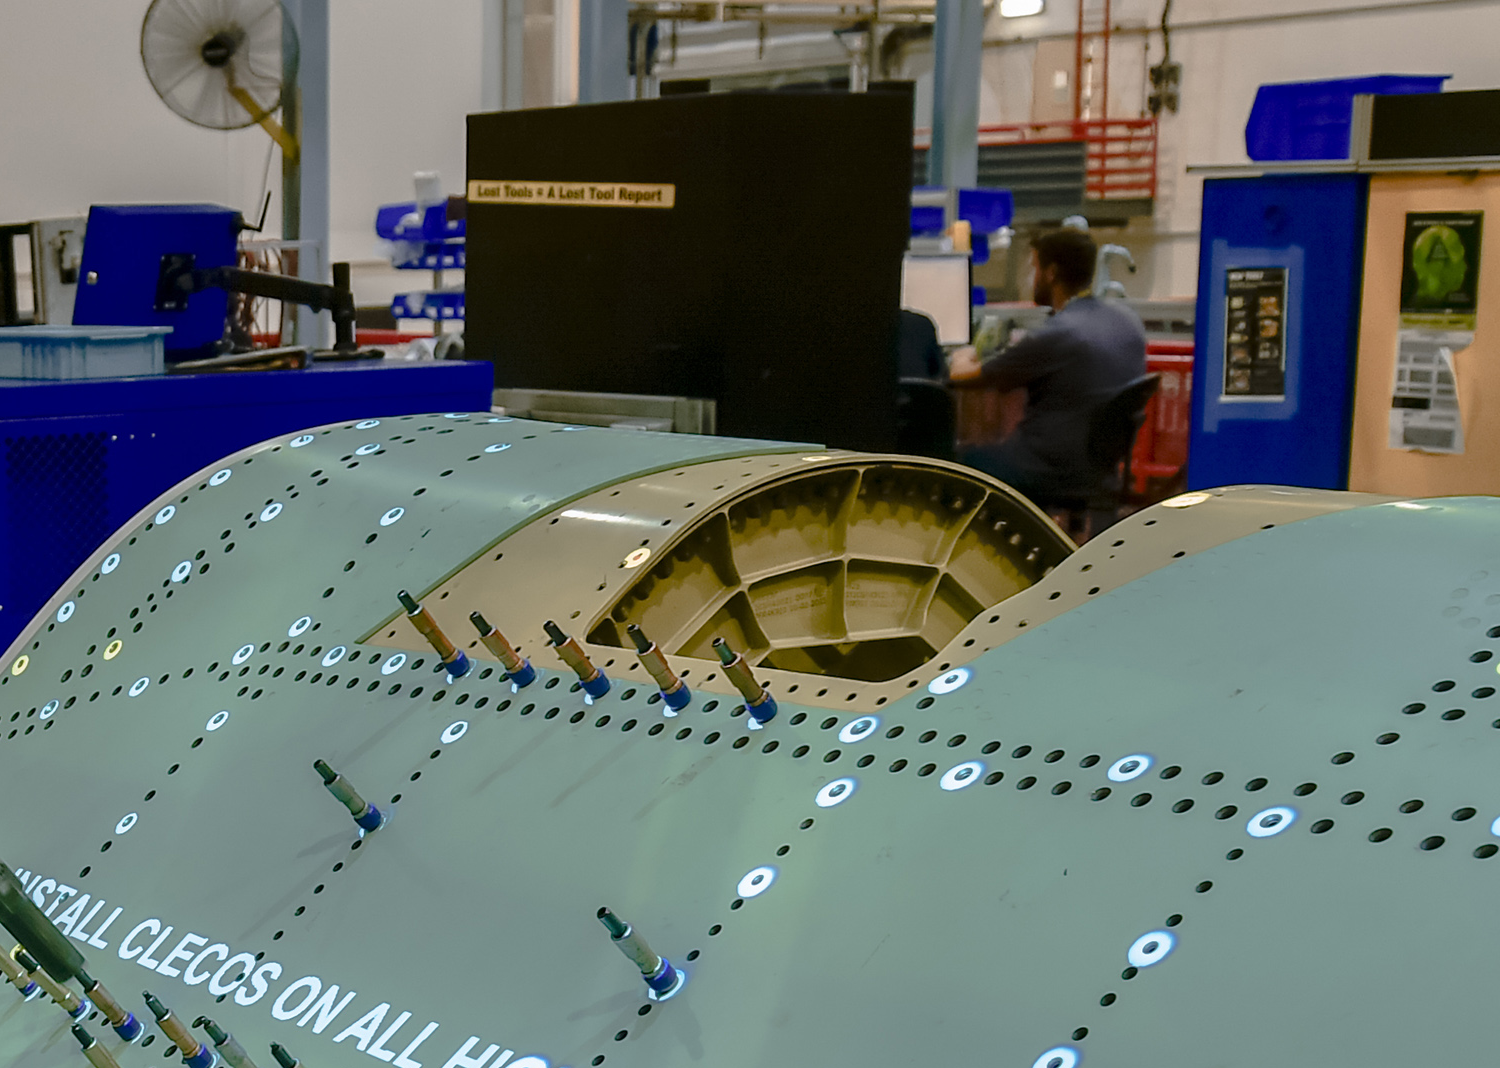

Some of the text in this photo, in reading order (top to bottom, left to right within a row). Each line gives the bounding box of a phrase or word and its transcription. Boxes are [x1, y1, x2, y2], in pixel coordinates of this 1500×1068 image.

[477, 184, 500, 197] Lost
[503, 184, 533, 198] Tools
[547, 185, 556, 199] A
[559, 186, 584, 199] Lost
[589, 186, 615, 200] Tool
[619, 186, 662, 203] Report
[14, 867, 124, 950] NSTALL
[117, 917, 283, 1006] CLECOS
[271, 975, 357, 1035] ON
